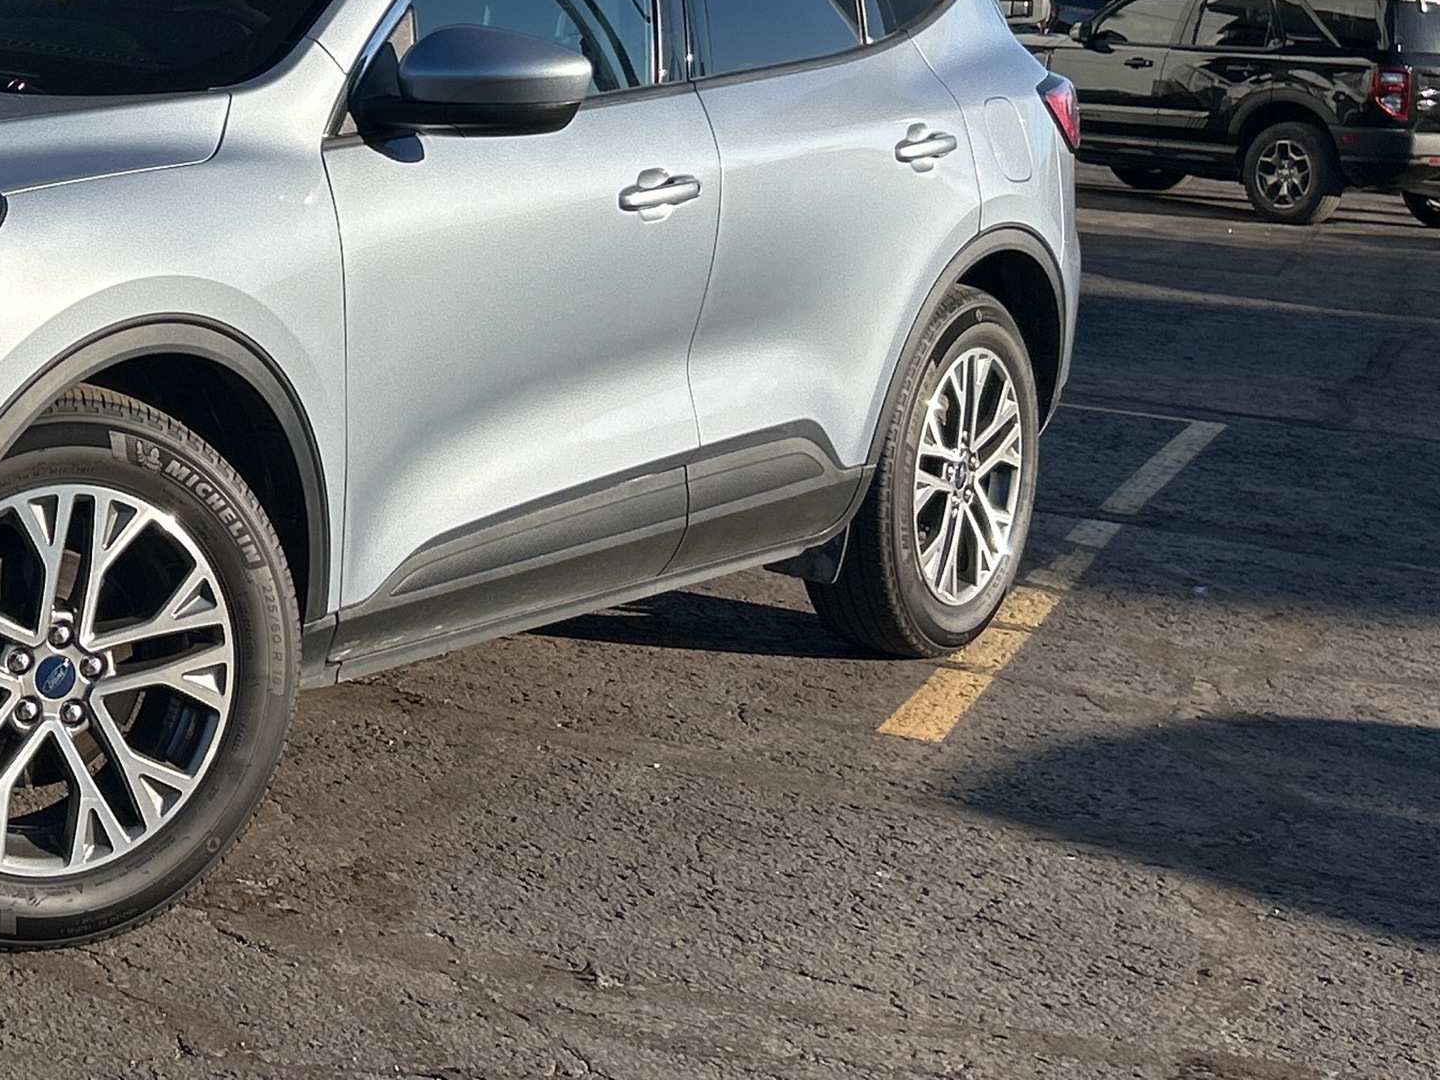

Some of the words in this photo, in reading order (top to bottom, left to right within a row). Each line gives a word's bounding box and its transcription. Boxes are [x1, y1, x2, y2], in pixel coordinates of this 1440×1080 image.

[163, 458, 261, 564] MICHELIN
[262, 583, 283, 644] 225/60
[273, 652, 283, 664] R
